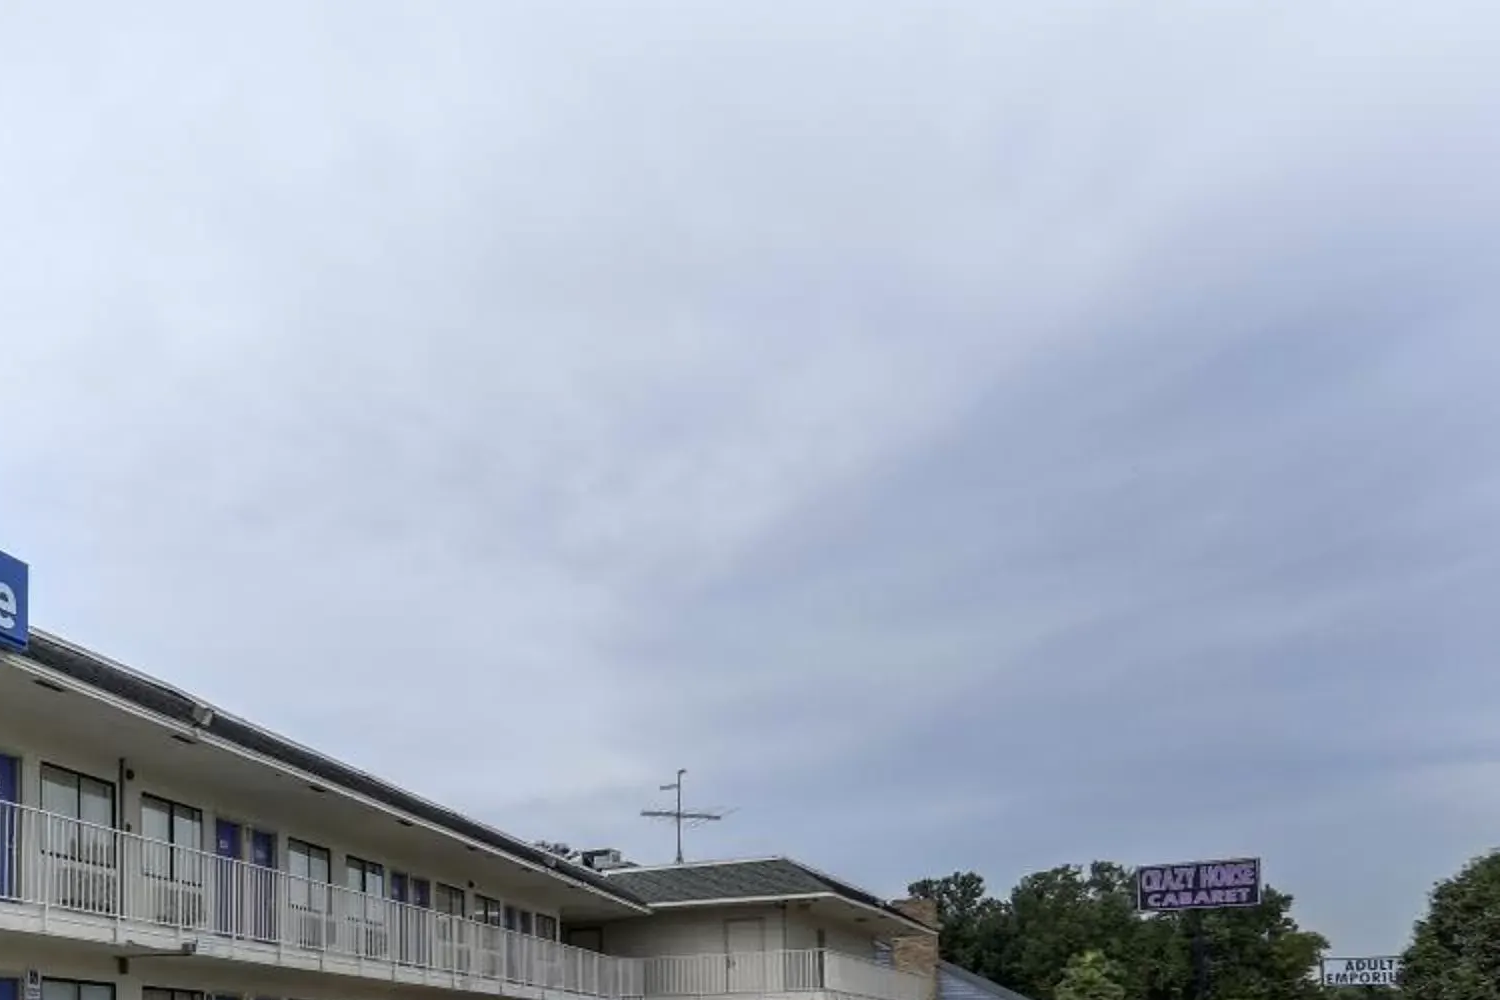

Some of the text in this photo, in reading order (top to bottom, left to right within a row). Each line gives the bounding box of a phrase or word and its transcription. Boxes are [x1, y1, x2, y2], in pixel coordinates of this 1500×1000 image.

[1142, 863, 1255, 892] CRAZY HORSE
[1147, 887, 1250, 907] CABARET
[1345, 959, 1395, 971] ADULT
[1326, 971, 1399, 985] EMPORIU
